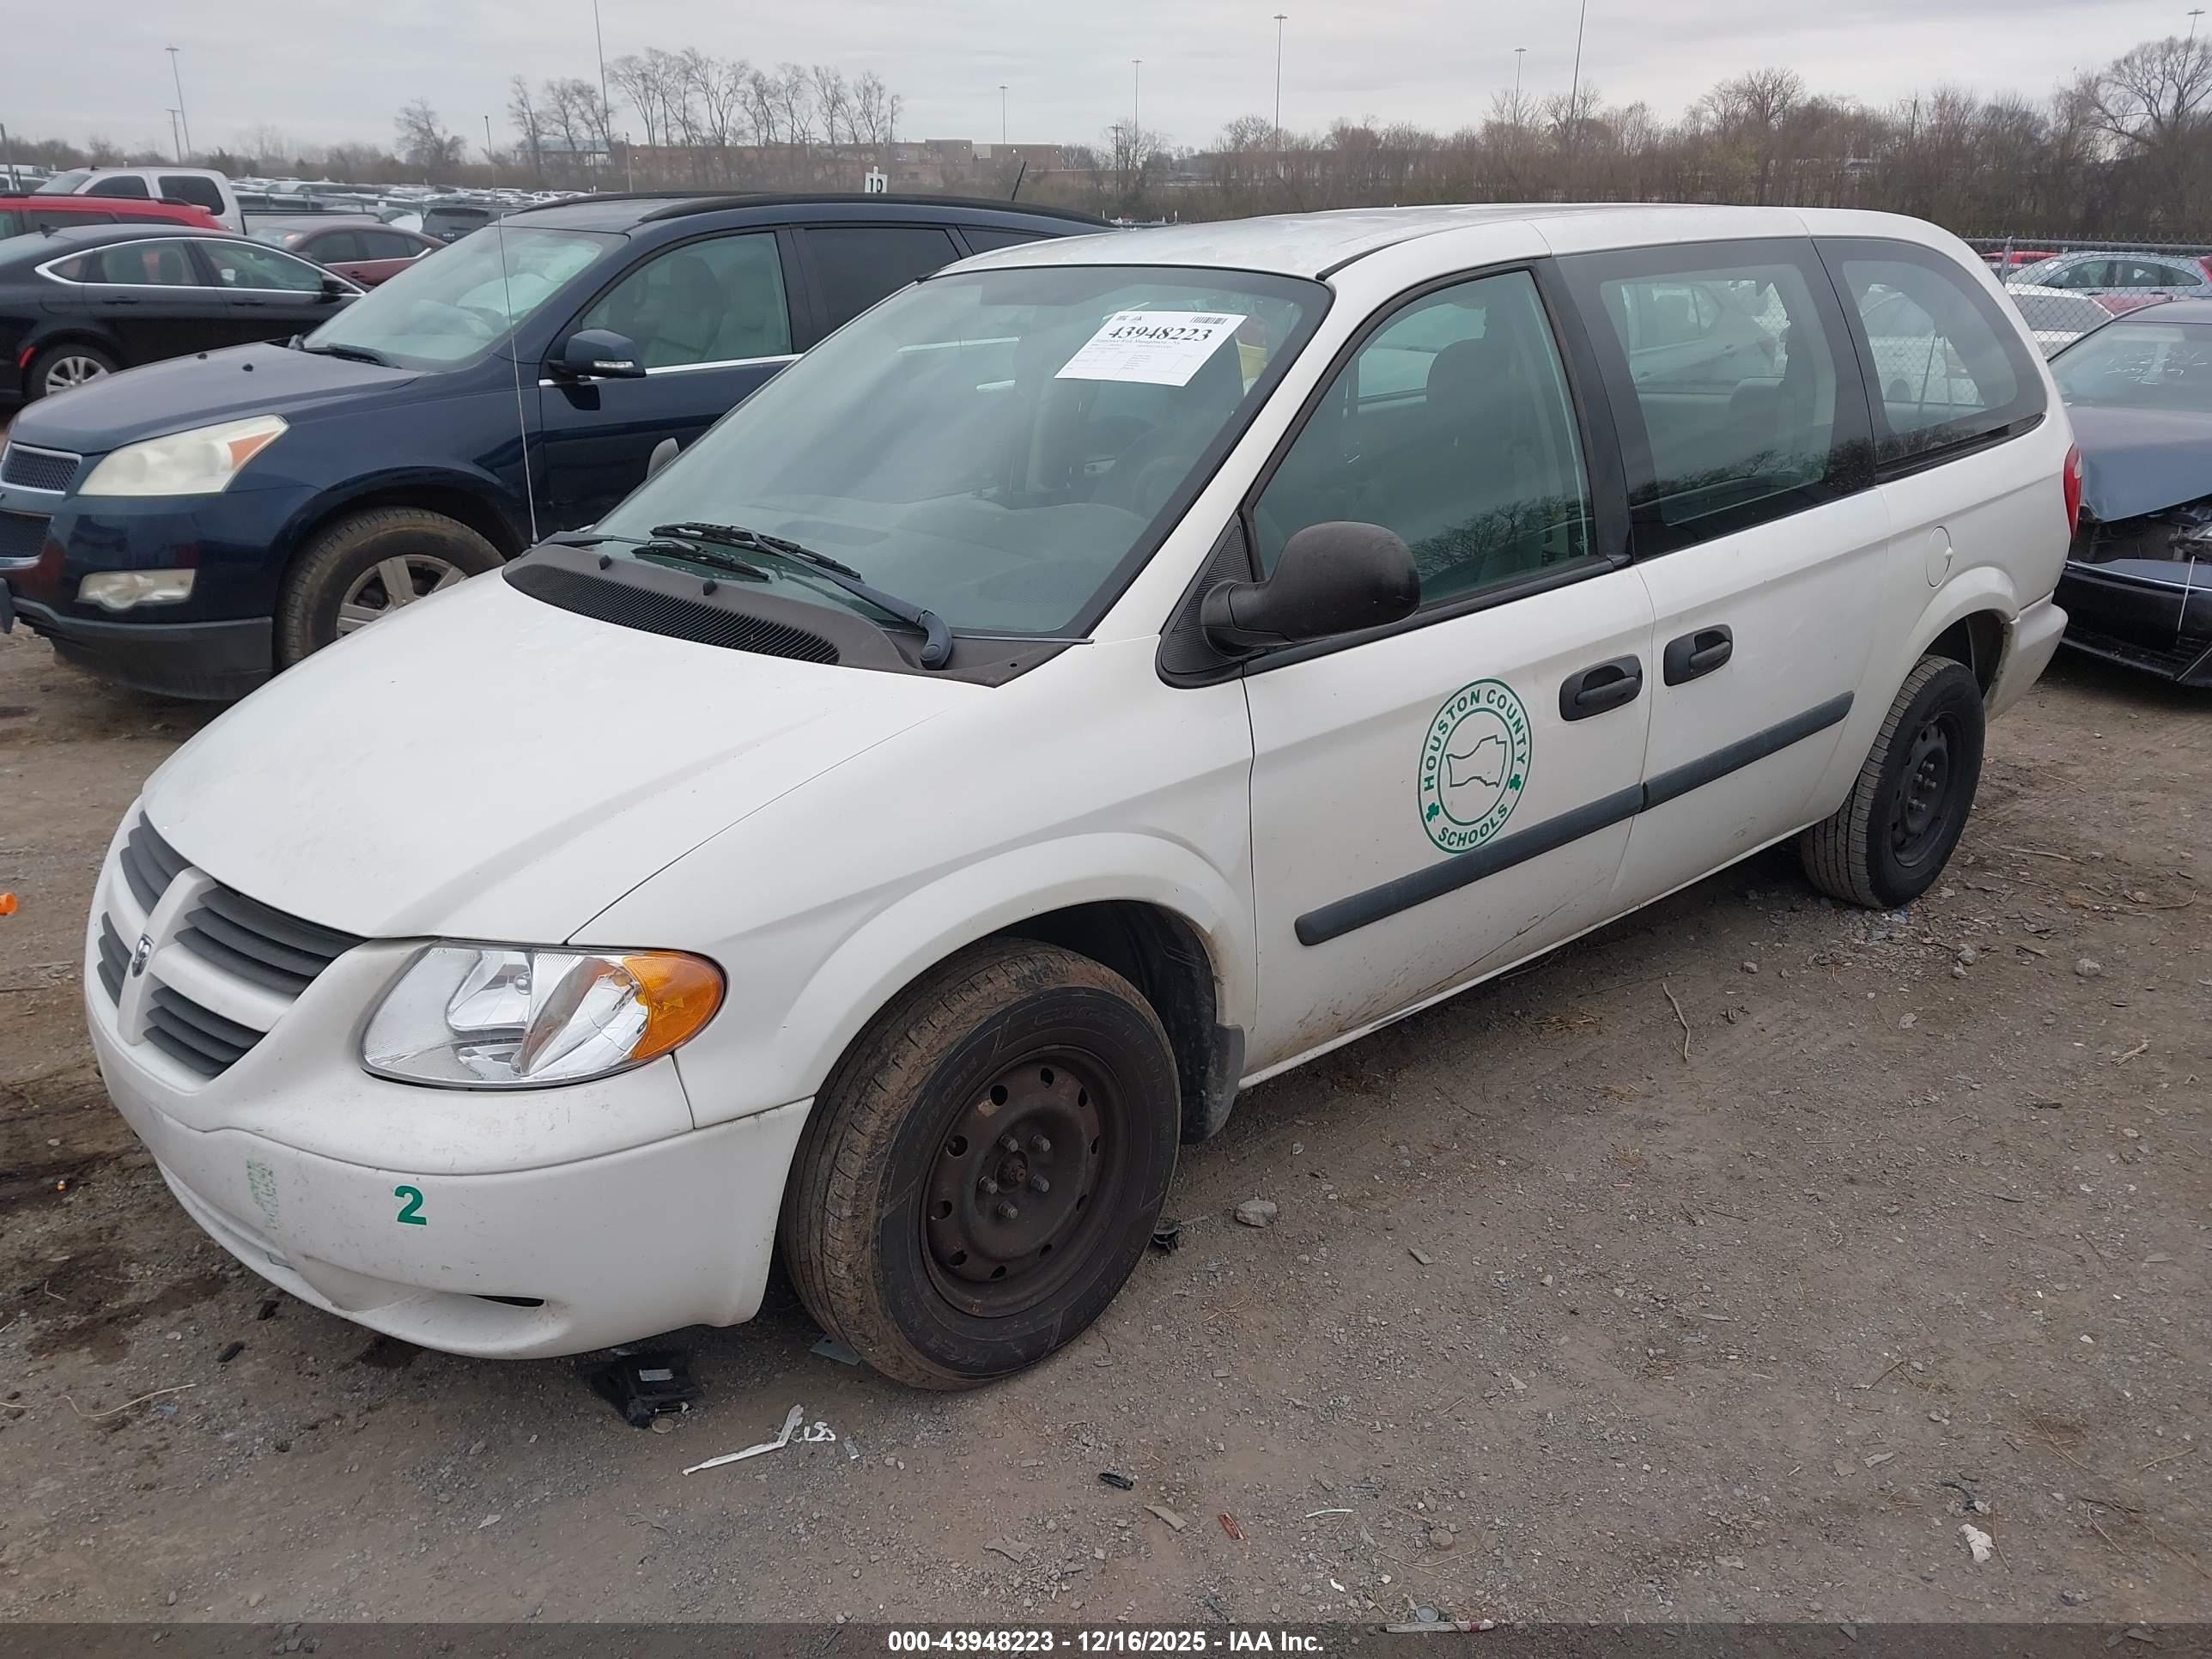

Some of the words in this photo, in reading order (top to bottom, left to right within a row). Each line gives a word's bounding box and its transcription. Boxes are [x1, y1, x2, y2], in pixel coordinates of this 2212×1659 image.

[1108, 325, 1213, 342] 43948223
[1423, 688, 1481, 792] HOUSTON
[1486, 689, 1527, 765] COUNTY
[1437, 803, 1508, 847] SCHOOLS
[394, 1185, 428, 1225] 2
